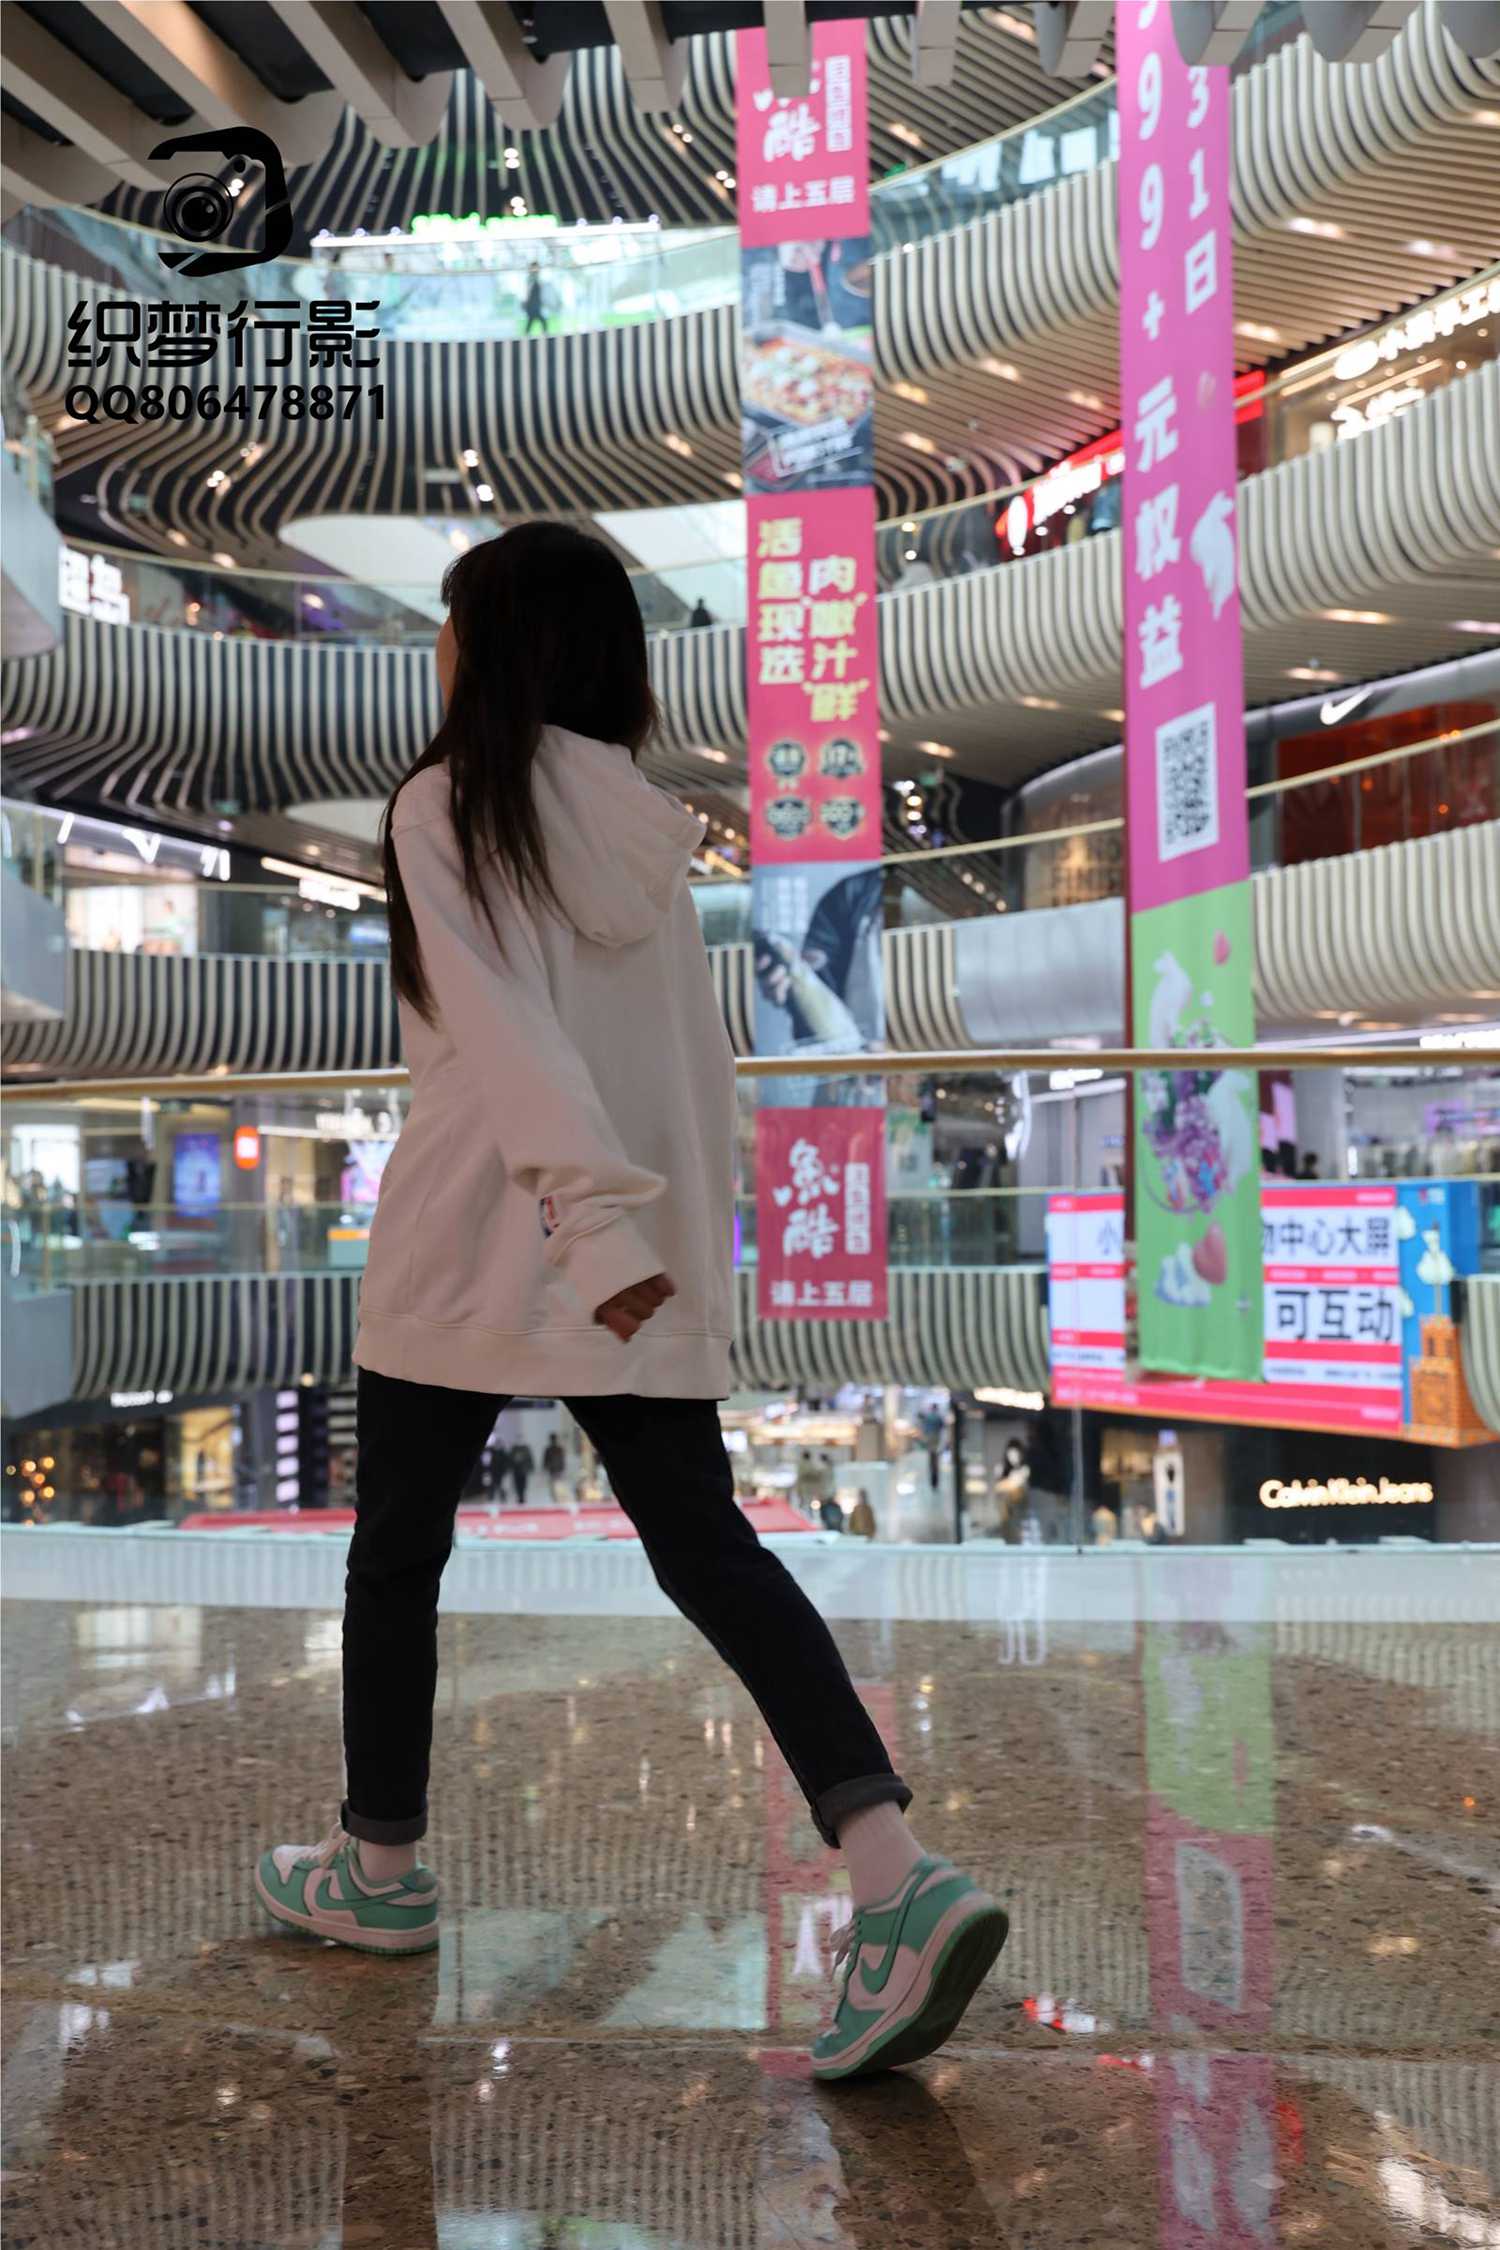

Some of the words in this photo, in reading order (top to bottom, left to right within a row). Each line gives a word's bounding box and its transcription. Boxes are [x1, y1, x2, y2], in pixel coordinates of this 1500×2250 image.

[752, 175, 855, 213] 请上五层
[757, 517, 804, 685] 活鱼现选
[771, 1280, 872, 1307] 请上五层
[1274, 1289, 1394, 1342] 可互动
